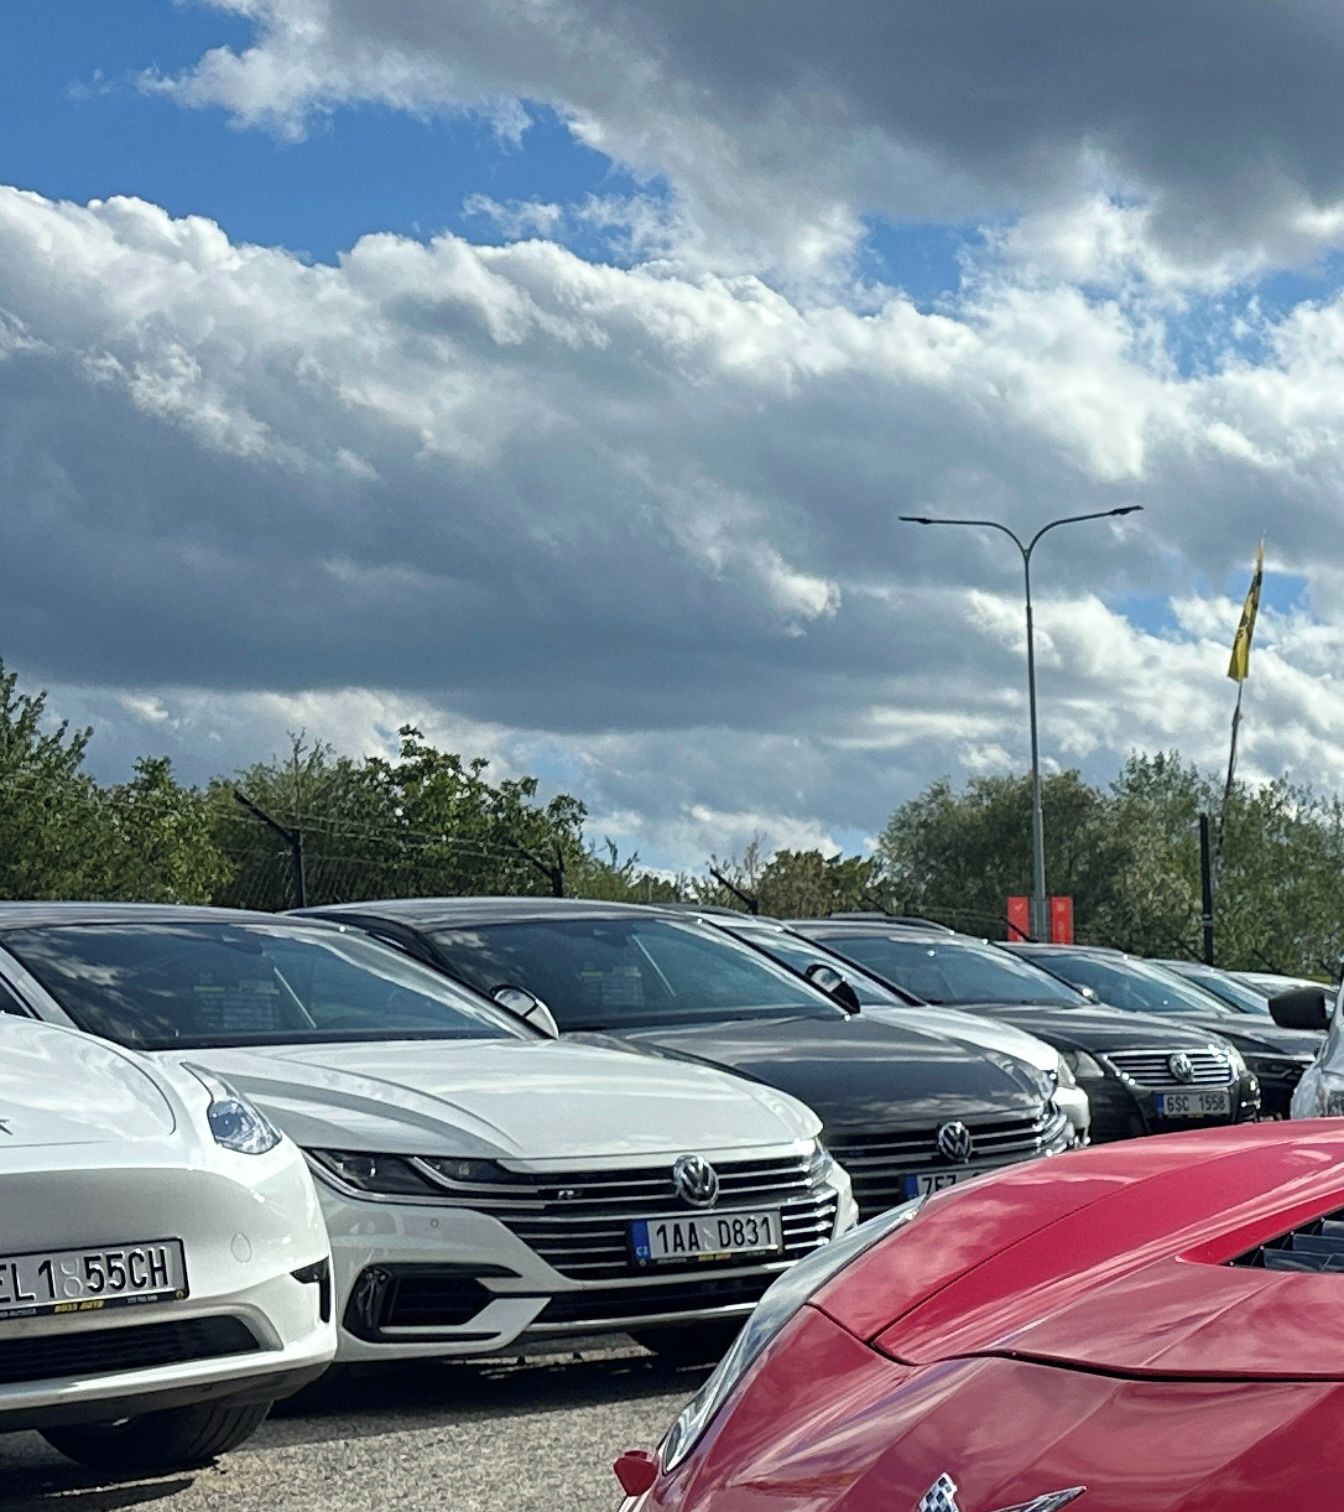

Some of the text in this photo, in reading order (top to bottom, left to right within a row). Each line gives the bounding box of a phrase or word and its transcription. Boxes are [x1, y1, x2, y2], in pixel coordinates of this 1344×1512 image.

[656, 1221, 701, 1254] 1AA
[717, 1216, 773, 1248] D831
[83, 1246, 170, 1293] 55CH
